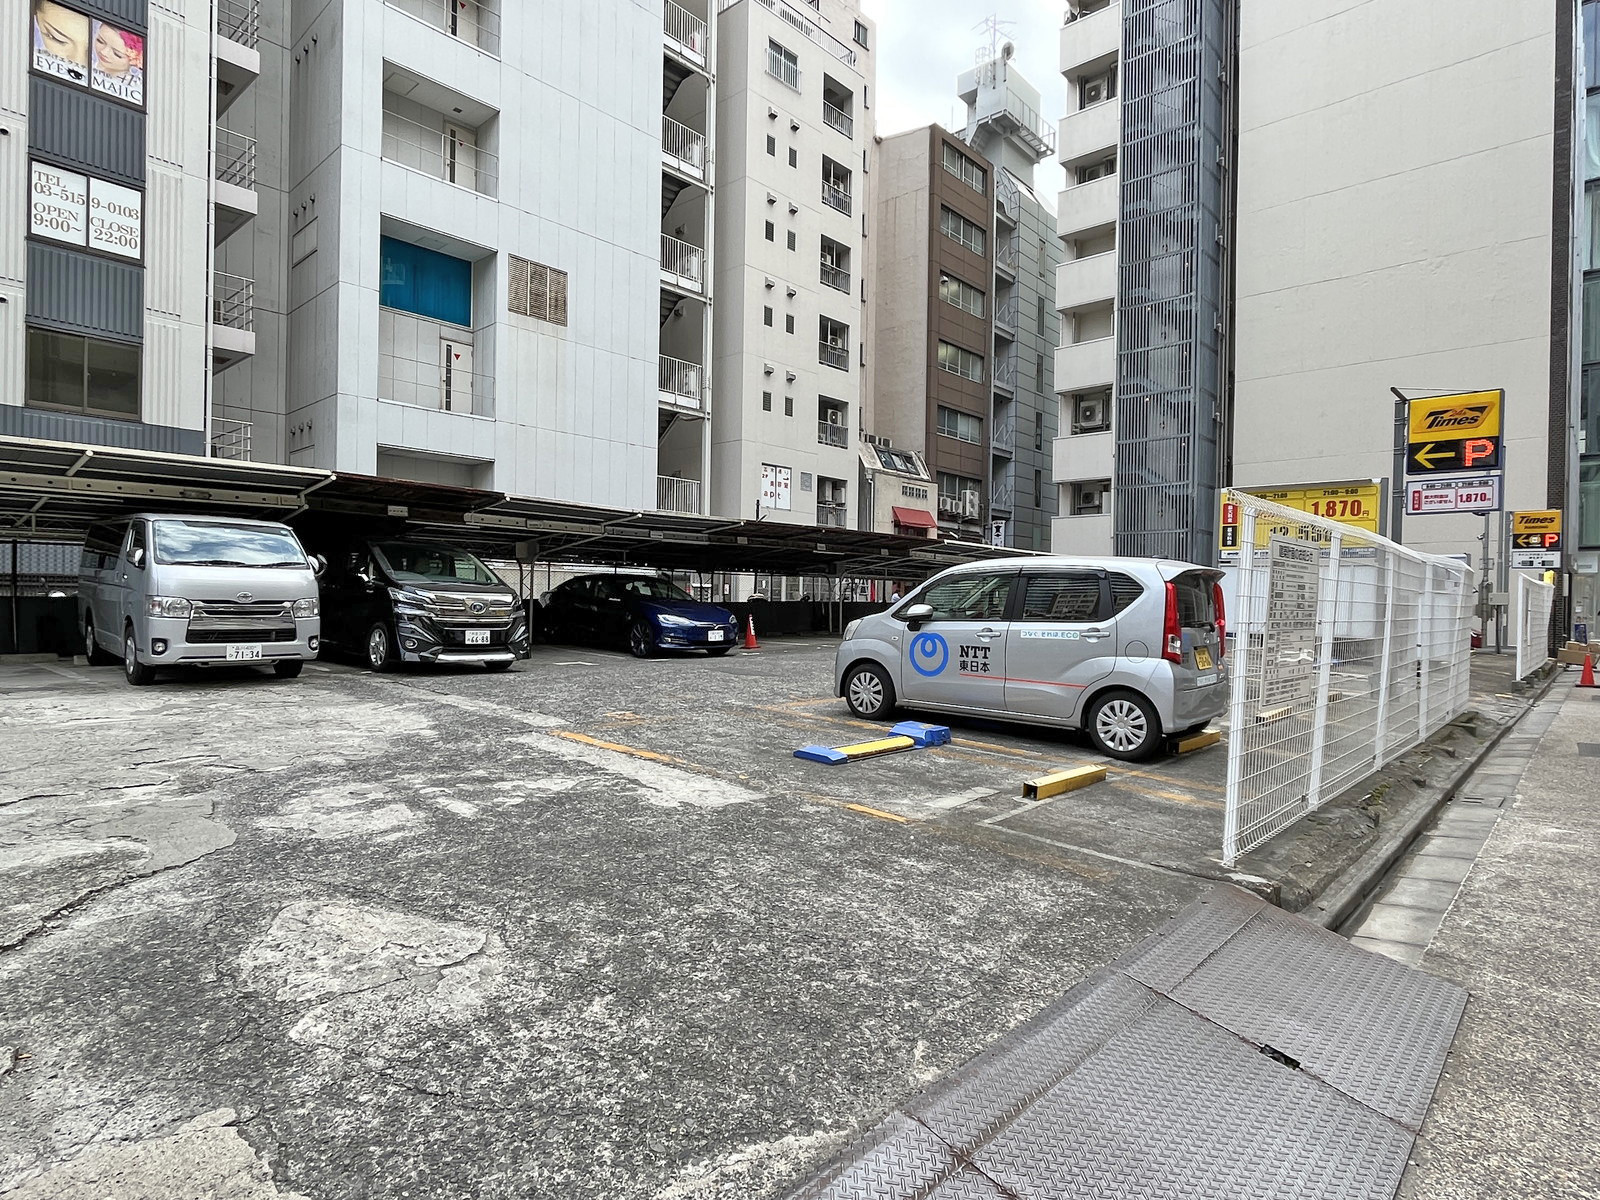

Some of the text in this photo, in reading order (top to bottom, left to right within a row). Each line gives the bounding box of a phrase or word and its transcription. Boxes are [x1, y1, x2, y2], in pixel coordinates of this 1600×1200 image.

[36, 55, 141, 101] EYE MAJIC
[34, 170, 66, 188] TEL
[34, 202, 139, 237] OPEN CLOSE
[94, 228, 138, 249] 22:00
[1424, 412, 1481, 430] Times
[1465, 439, 1495, 467] P
[1518, 515, 1556, 524] Times
[1545, 533, 1559, 547] P
[234, 650, 260, 660] 71-34
[959, 645, 991, 660] NTT
[959, 660, 990, 673] 東日本
